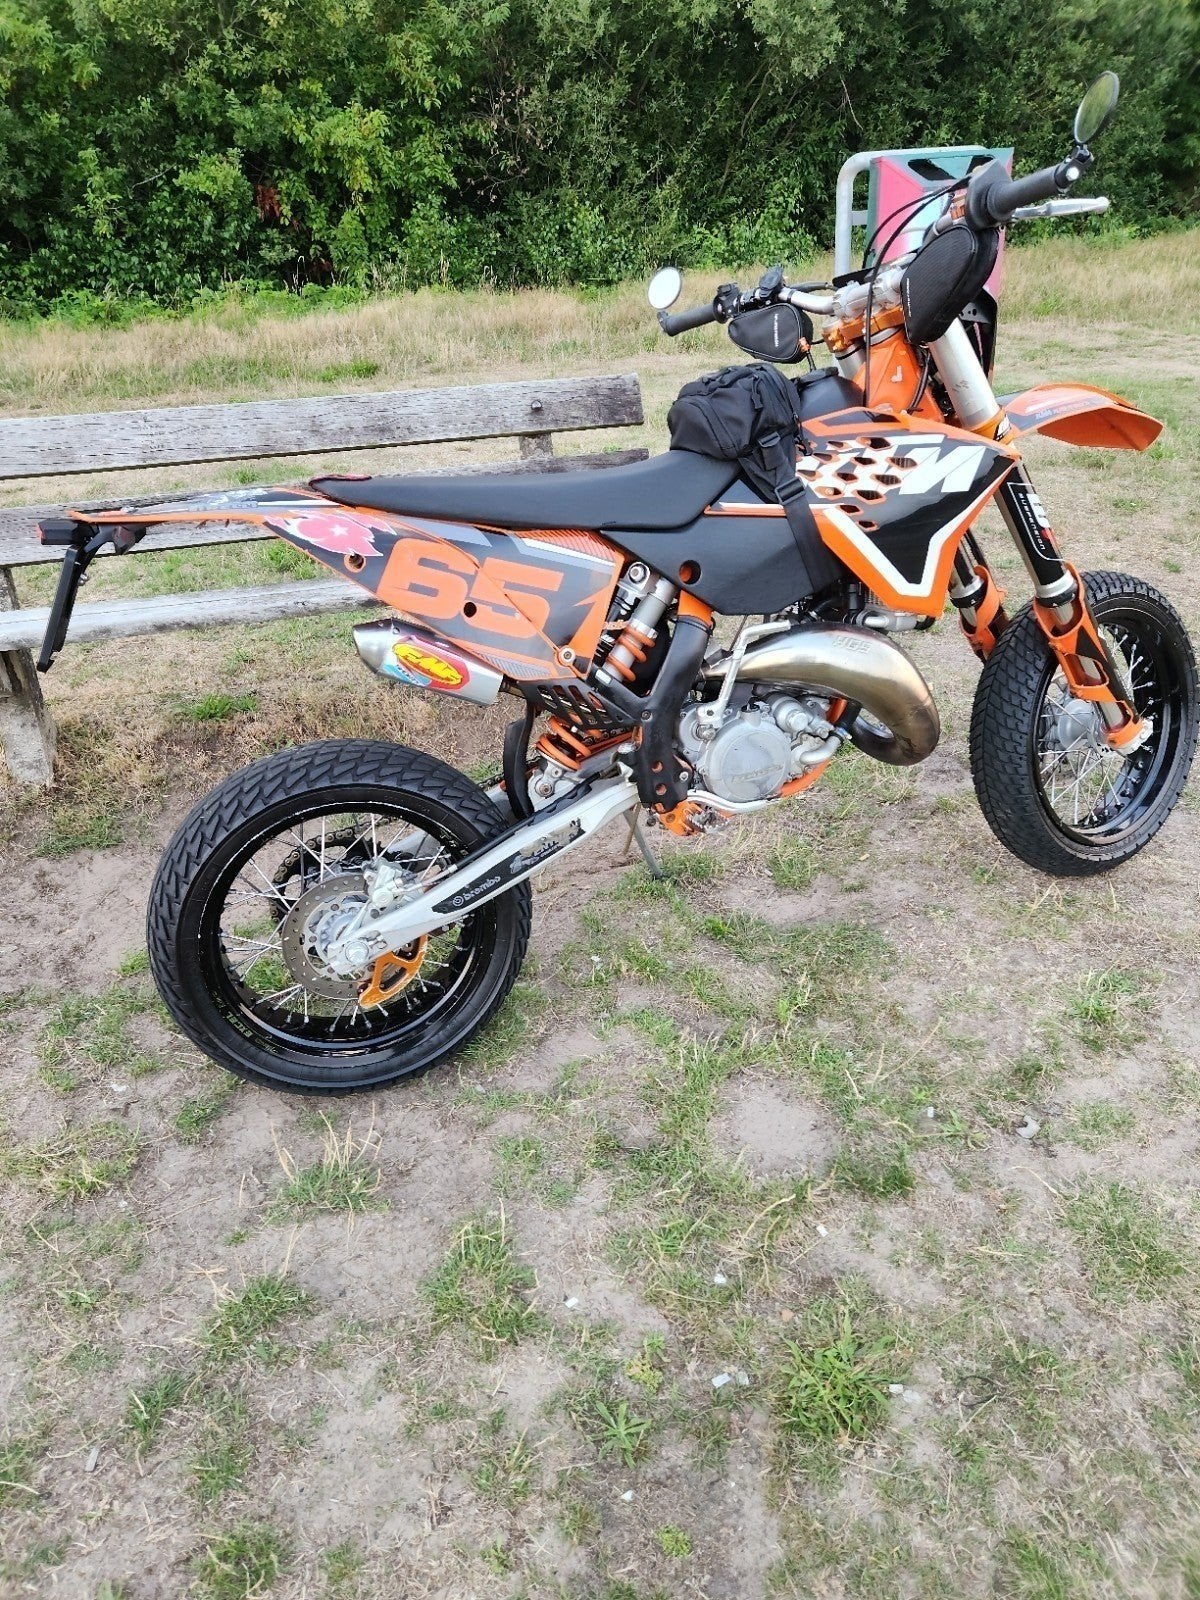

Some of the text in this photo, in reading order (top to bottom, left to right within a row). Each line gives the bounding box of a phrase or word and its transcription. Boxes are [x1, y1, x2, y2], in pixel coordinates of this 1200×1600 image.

[376, 537, 564, 639] 65
[394, 644, 463, 684] FMF
[462, 876, 502, 902] brembo
